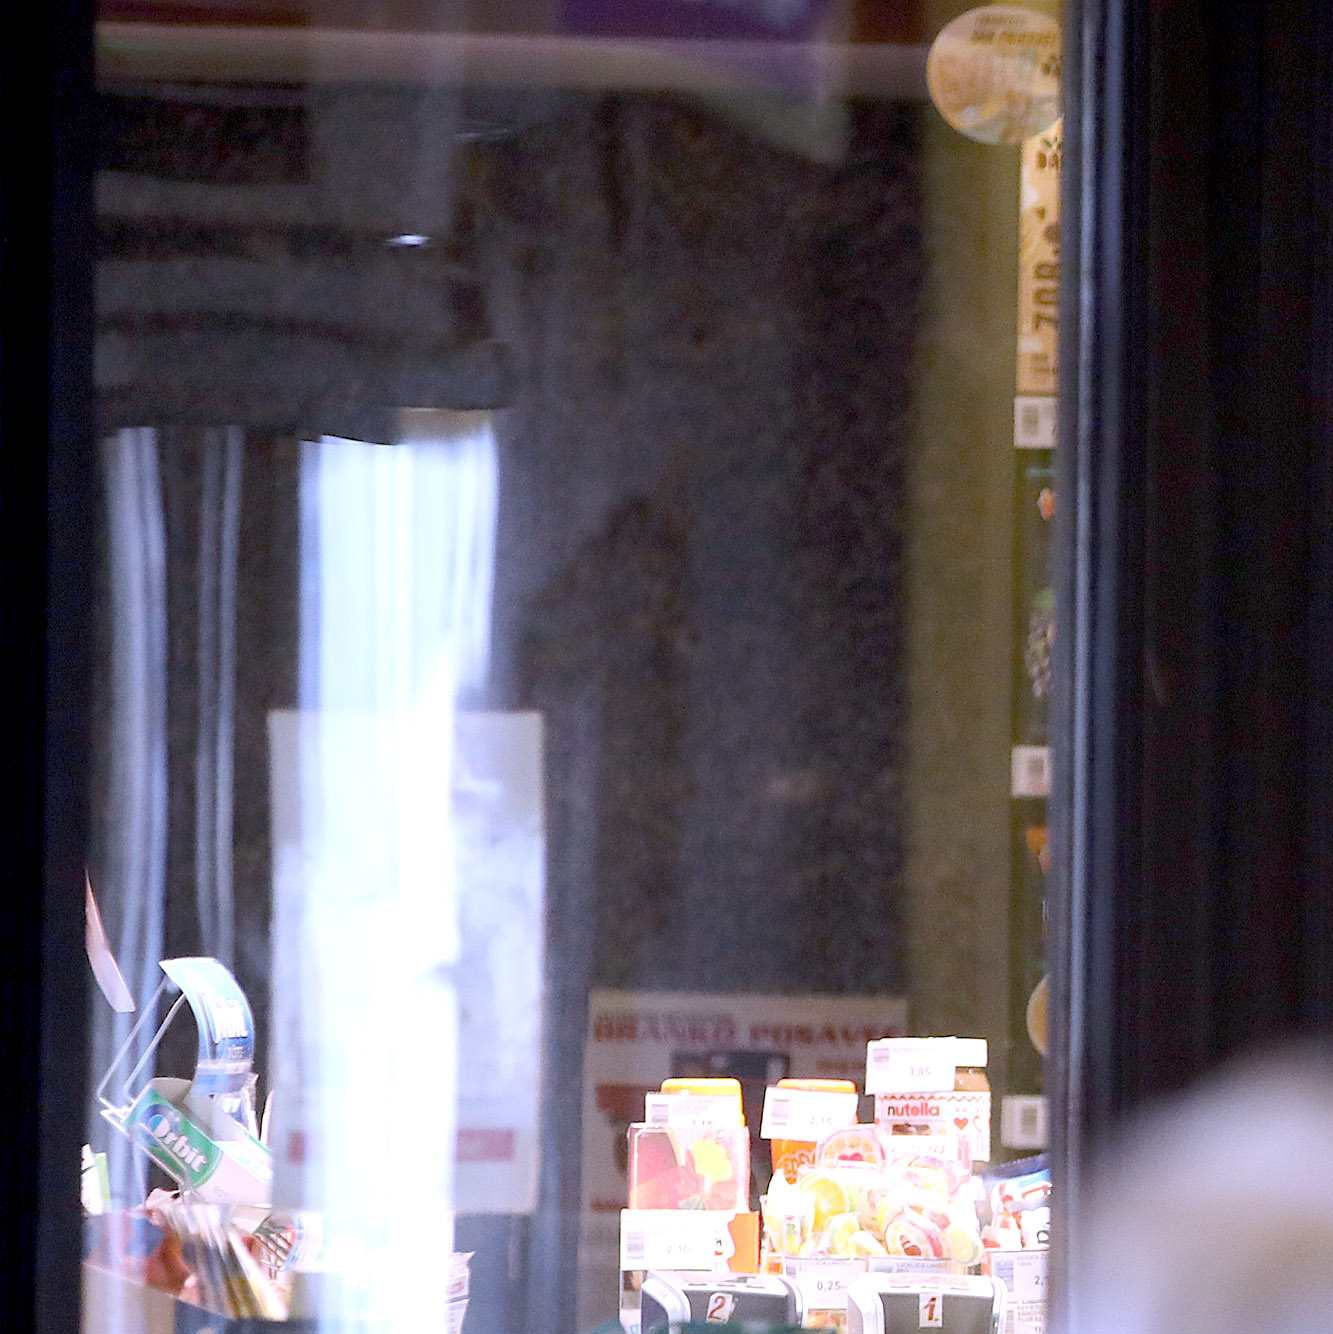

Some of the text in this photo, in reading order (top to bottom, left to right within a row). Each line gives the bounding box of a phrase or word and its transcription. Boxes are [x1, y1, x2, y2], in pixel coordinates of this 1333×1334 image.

[886, 1101, 941, 1119] nutella
[148, 1113, 207, 1173] Orbit
[816, 1280, 841, 1293] 0,25
